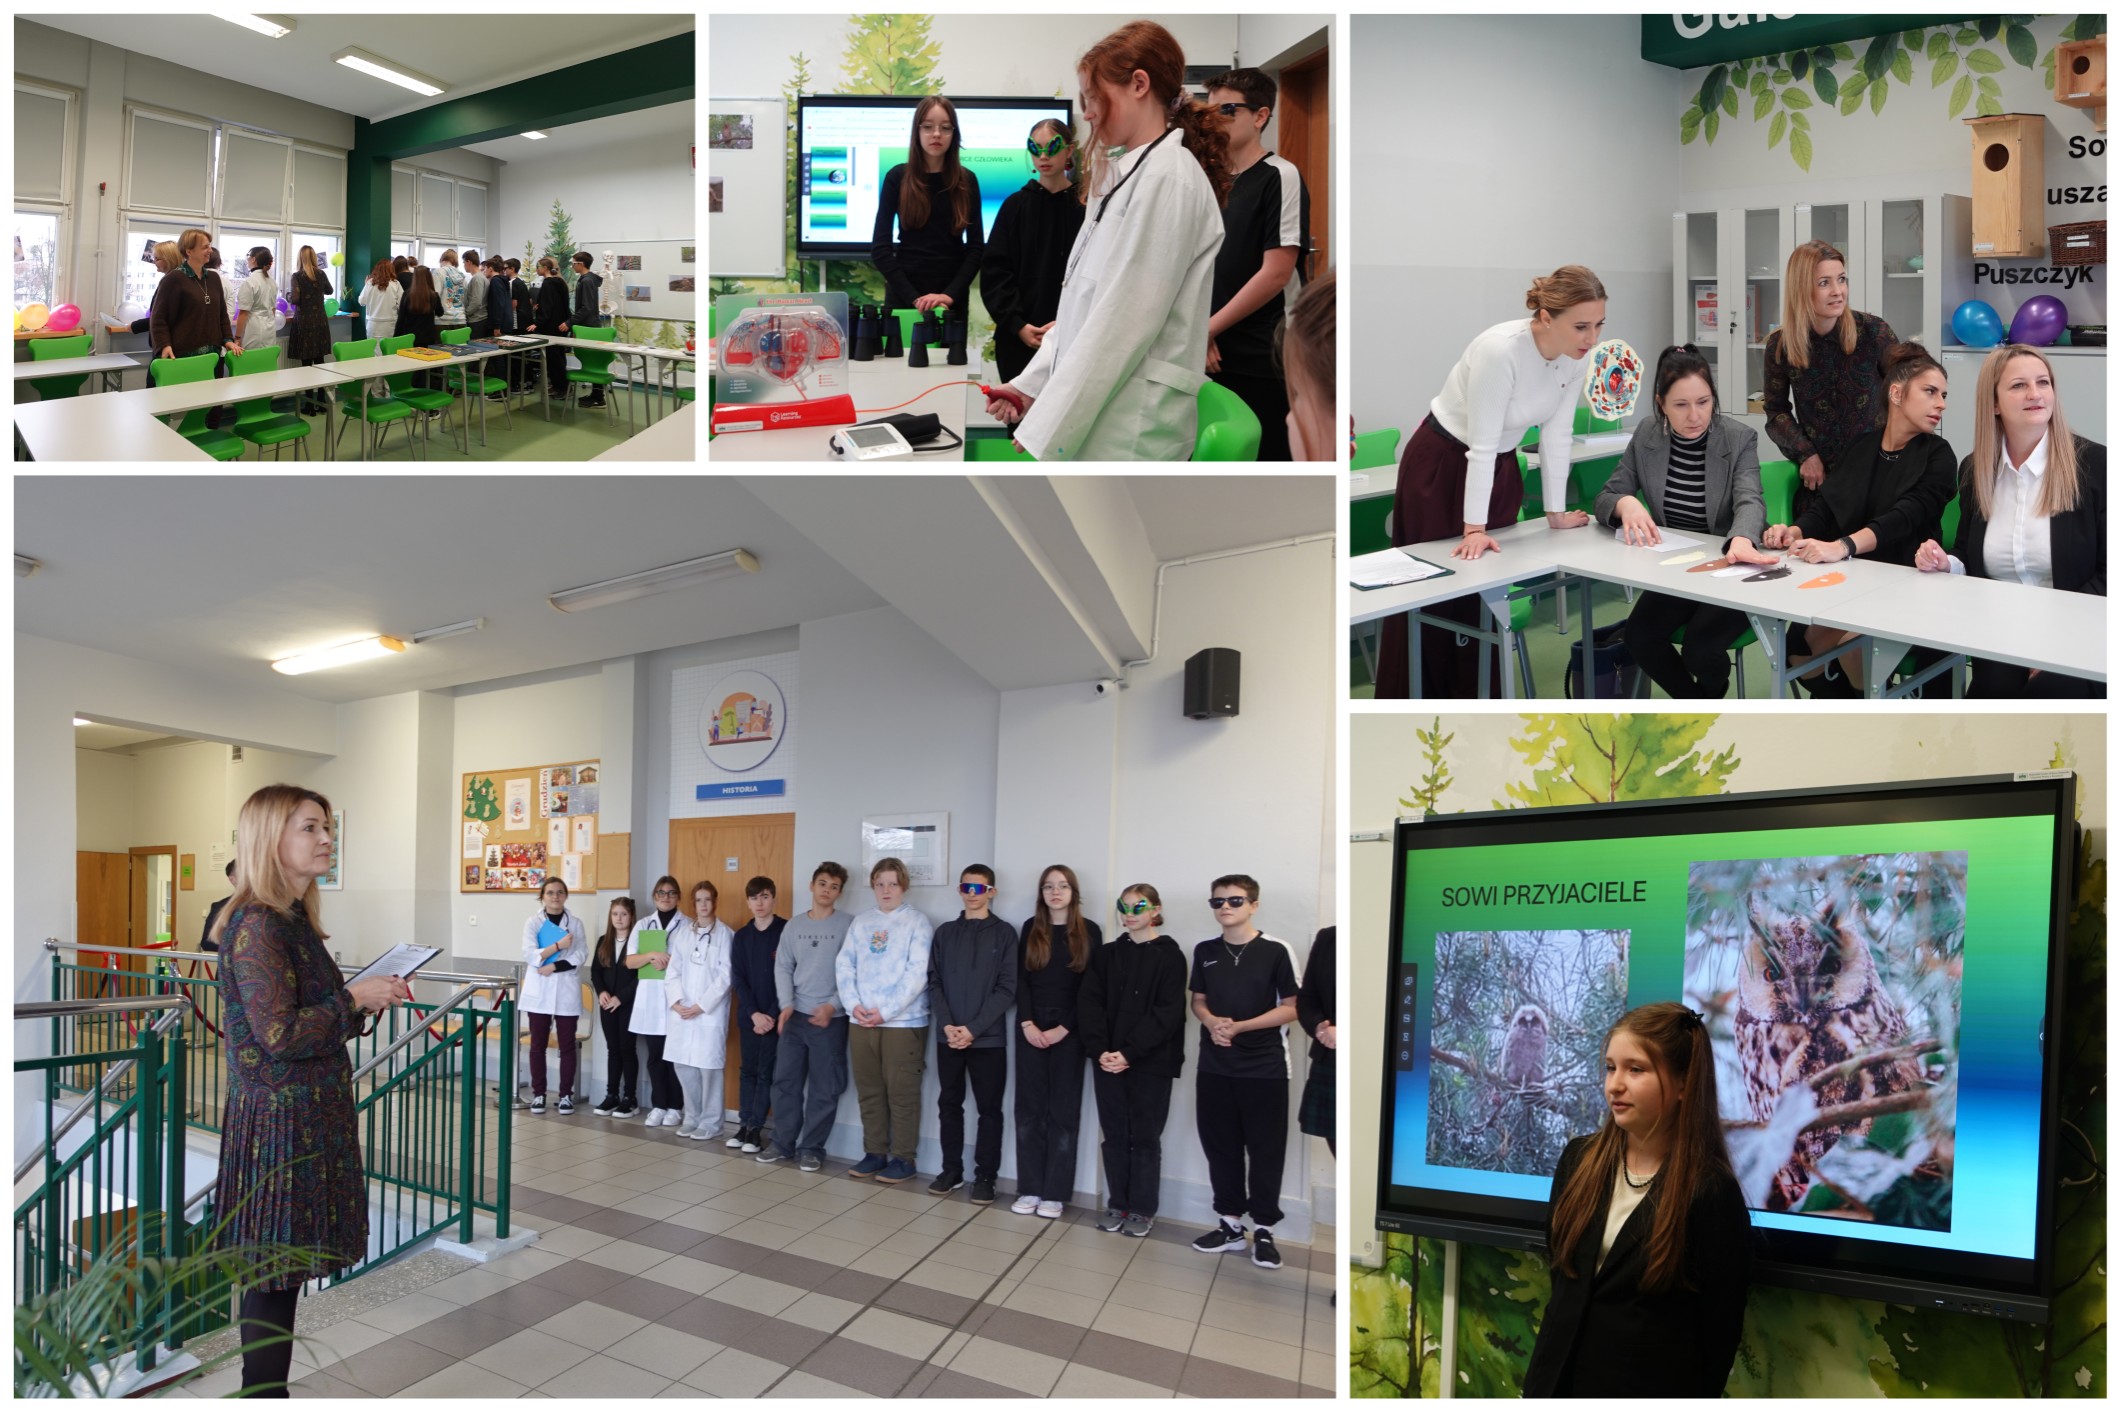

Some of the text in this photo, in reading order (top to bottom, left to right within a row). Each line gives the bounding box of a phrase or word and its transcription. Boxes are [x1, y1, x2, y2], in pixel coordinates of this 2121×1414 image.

[2069, 135, 2107, 158] So
[1974, 263, 2094, 289] Puszczyk
[722, 786, 758, 794] HISTORIA
[1441, 881, 1647, 907] SOWI PRZYJACIELE
